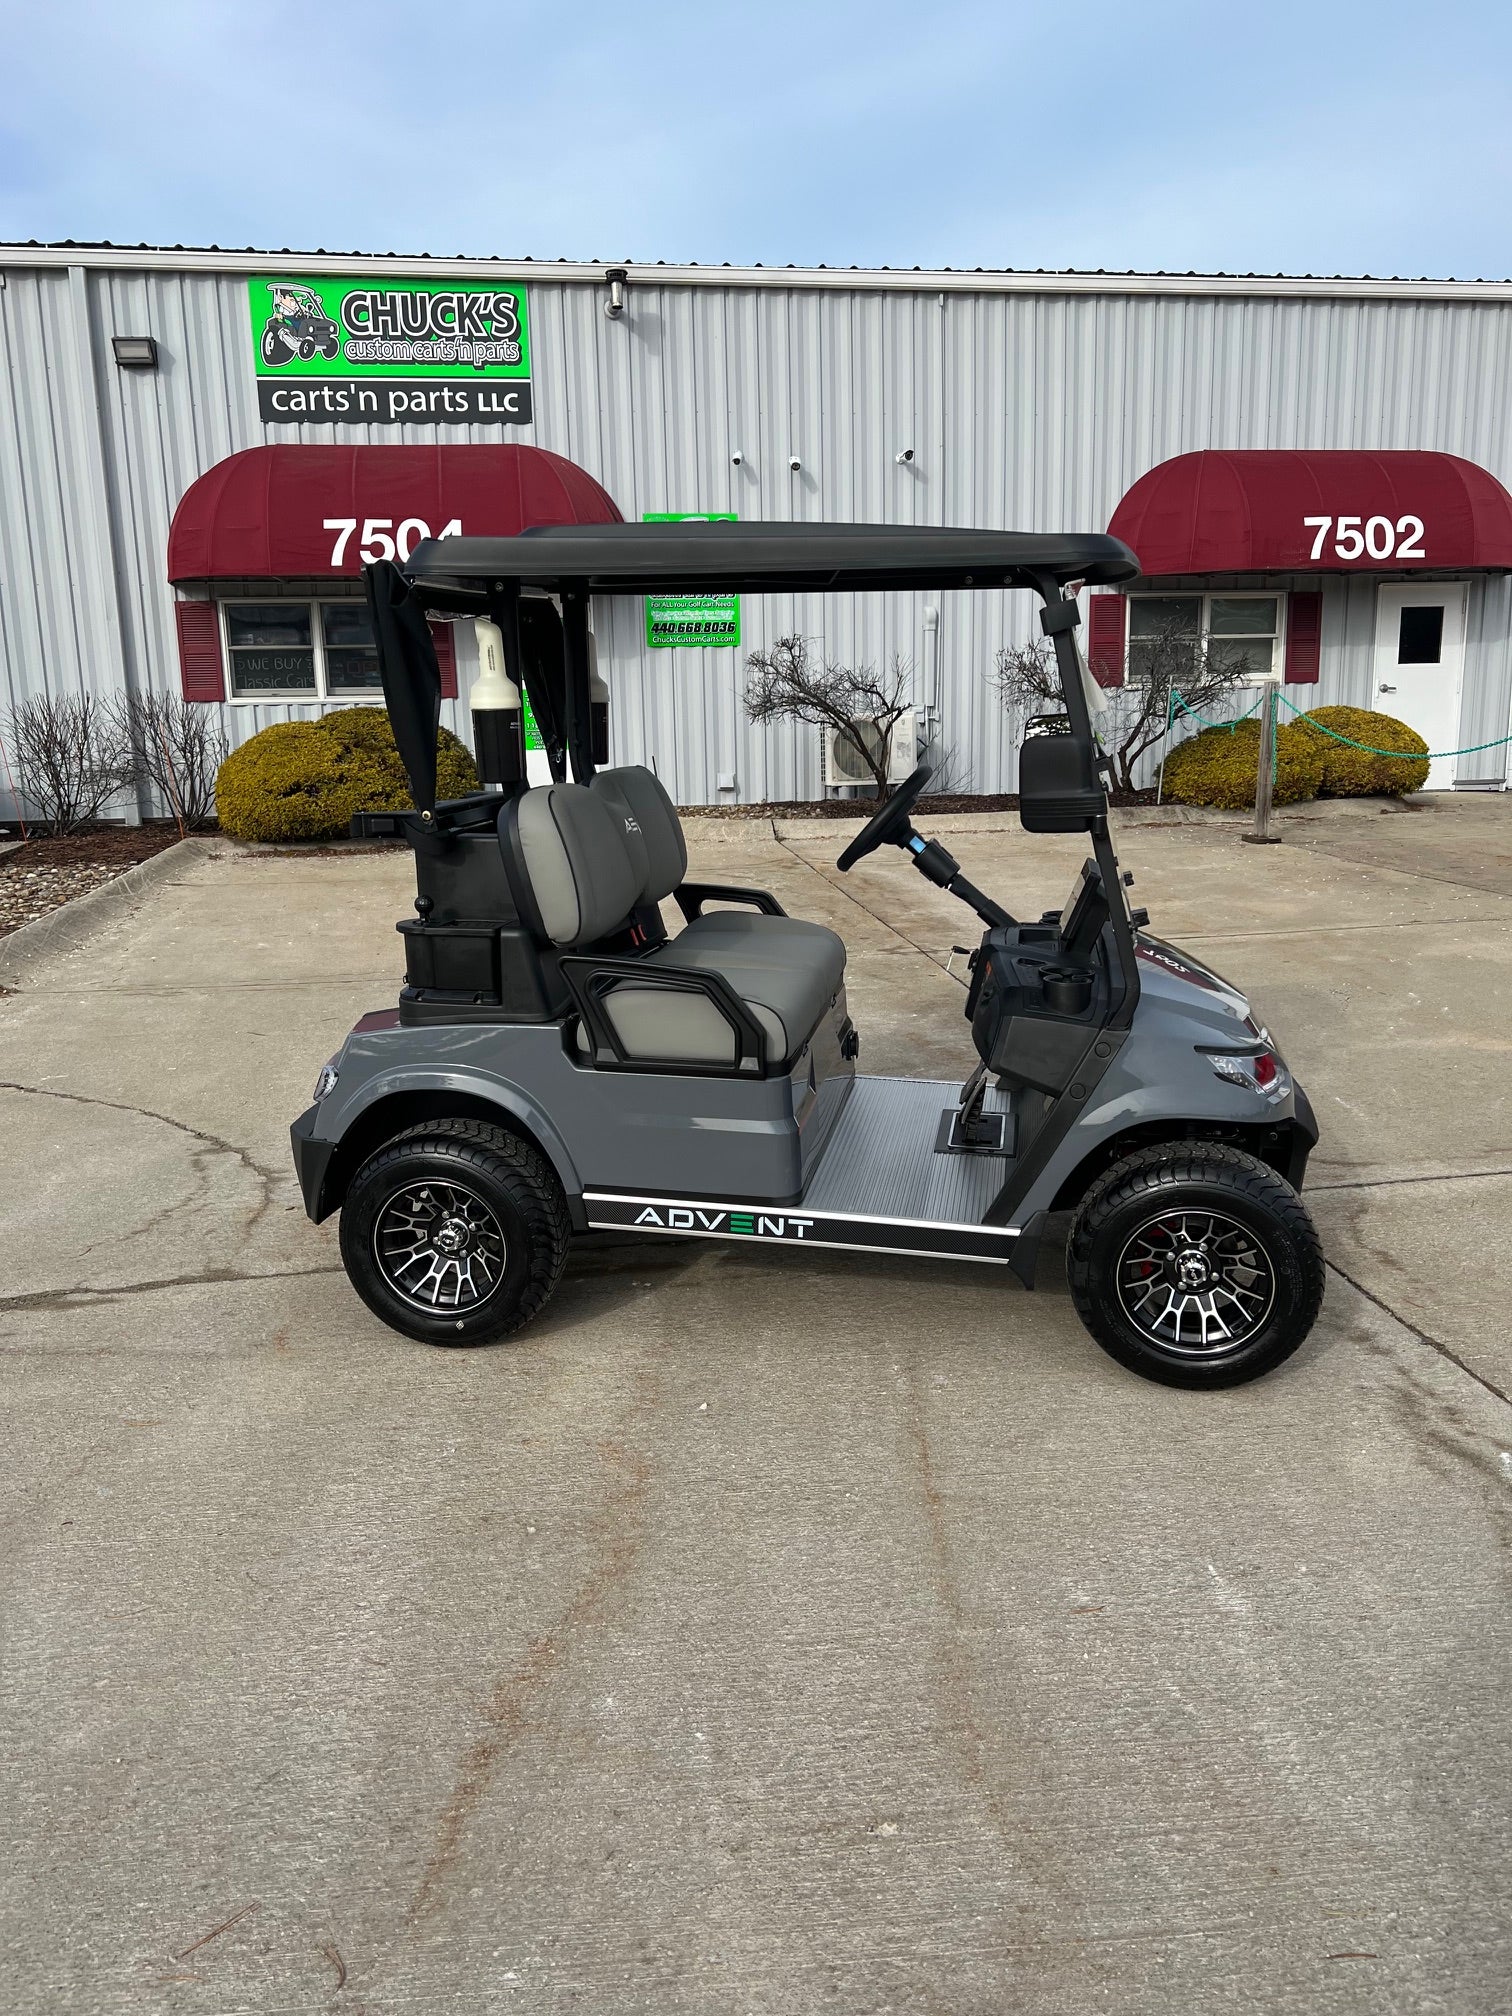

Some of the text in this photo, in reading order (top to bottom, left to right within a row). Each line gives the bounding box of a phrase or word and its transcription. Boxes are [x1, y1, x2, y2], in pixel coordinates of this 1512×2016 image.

[342, 291, 518, 337] CHUCK'S
[344, 340, 412, 360] custom
[474, 341, 518, 366] parts
[271, 384, 519, 418] carts'n parts LLC
[1303, 515, 1426, 560] 7502
[651, 622, 736, 634] 440.668.8036
[652, 635, 735, 643] ChucksCustomCarts.com
[247, 657, 270, 670] WE
[274, 657, 302, 670] BUY
[633, 1206, 814, 1238] ADVENT
